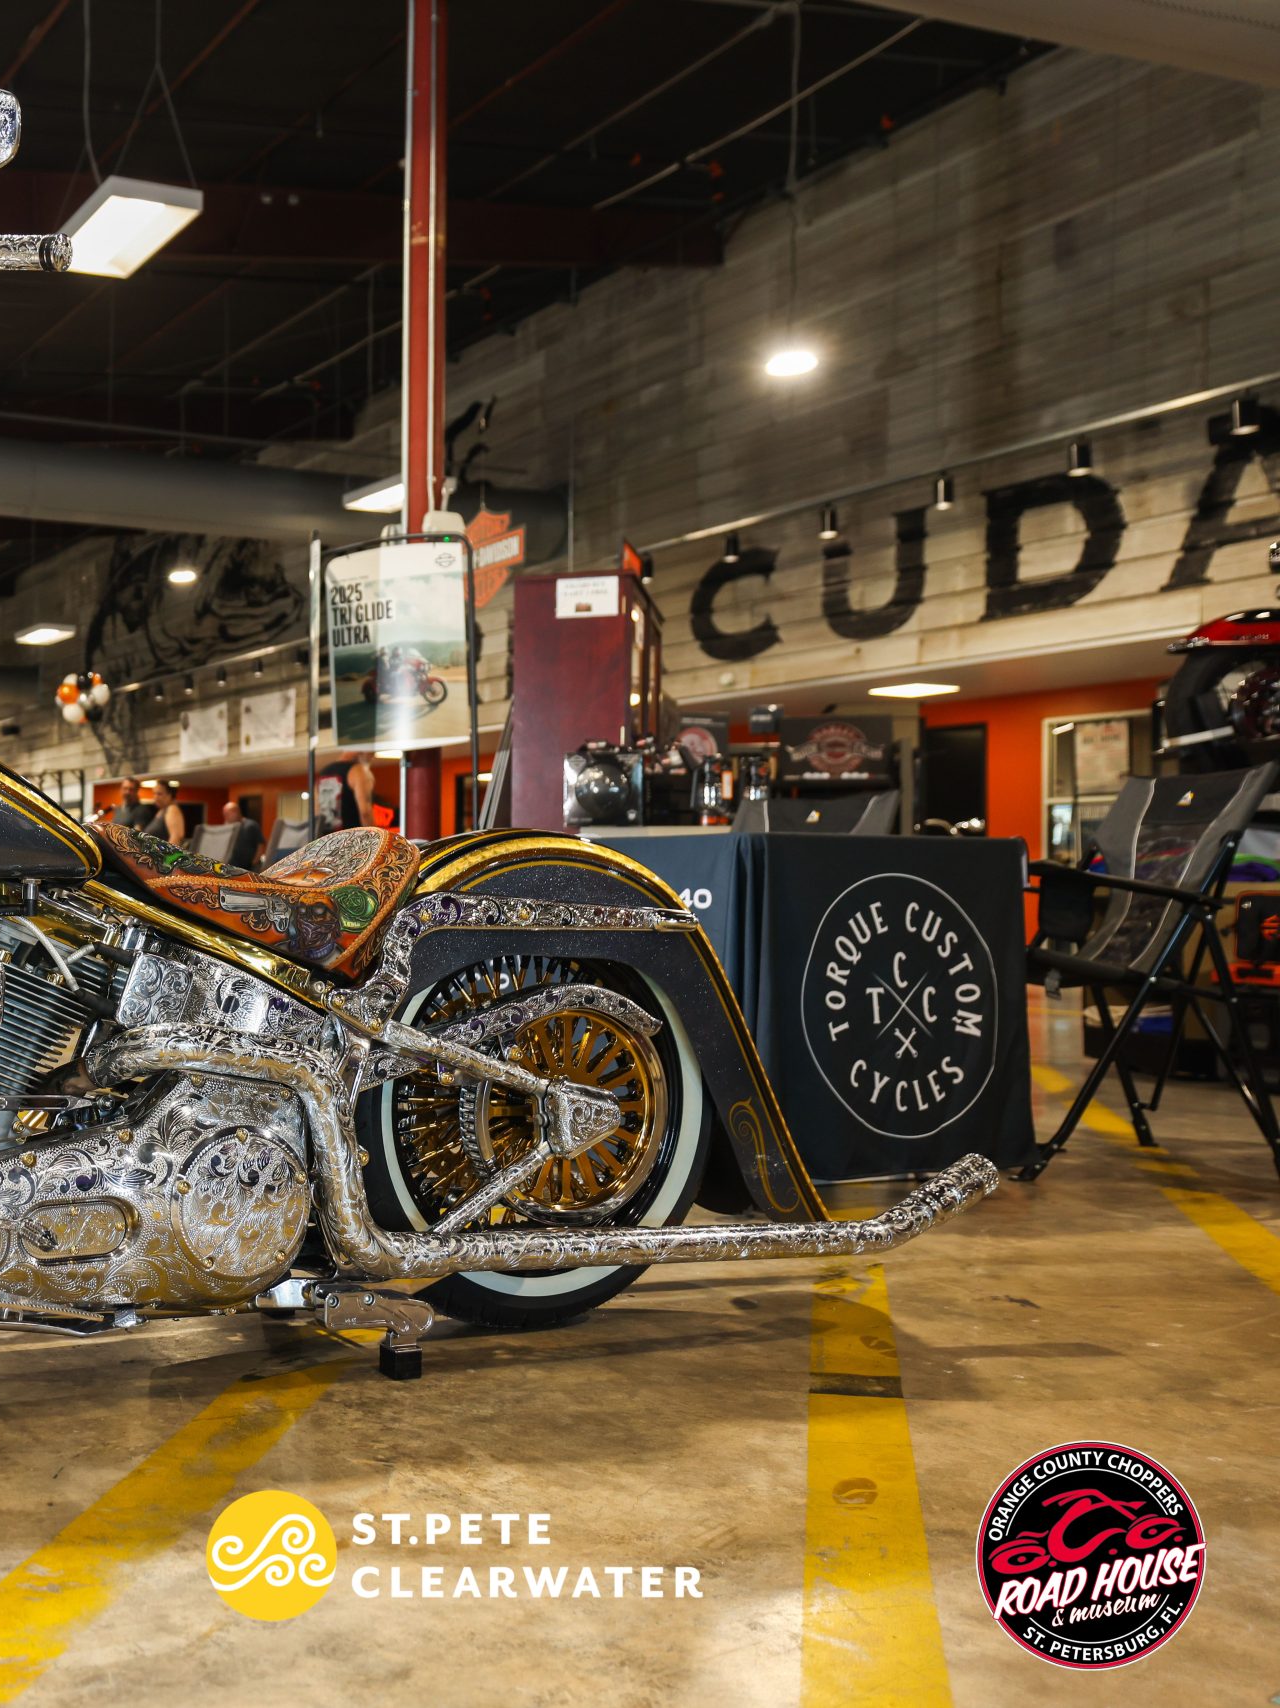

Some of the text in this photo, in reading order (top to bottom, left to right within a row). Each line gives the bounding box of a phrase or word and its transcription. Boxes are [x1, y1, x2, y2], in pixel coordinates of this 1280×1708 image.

[331, 583, 363, 606] 2025
[331, 600, 393, 627] TRI GLIDE
[332, 625, 371, 648] ULTRA
[825, 901, 984, 1042] TORQUE CUSTOM
[850, 1055, 965, 1112] CYCLES
